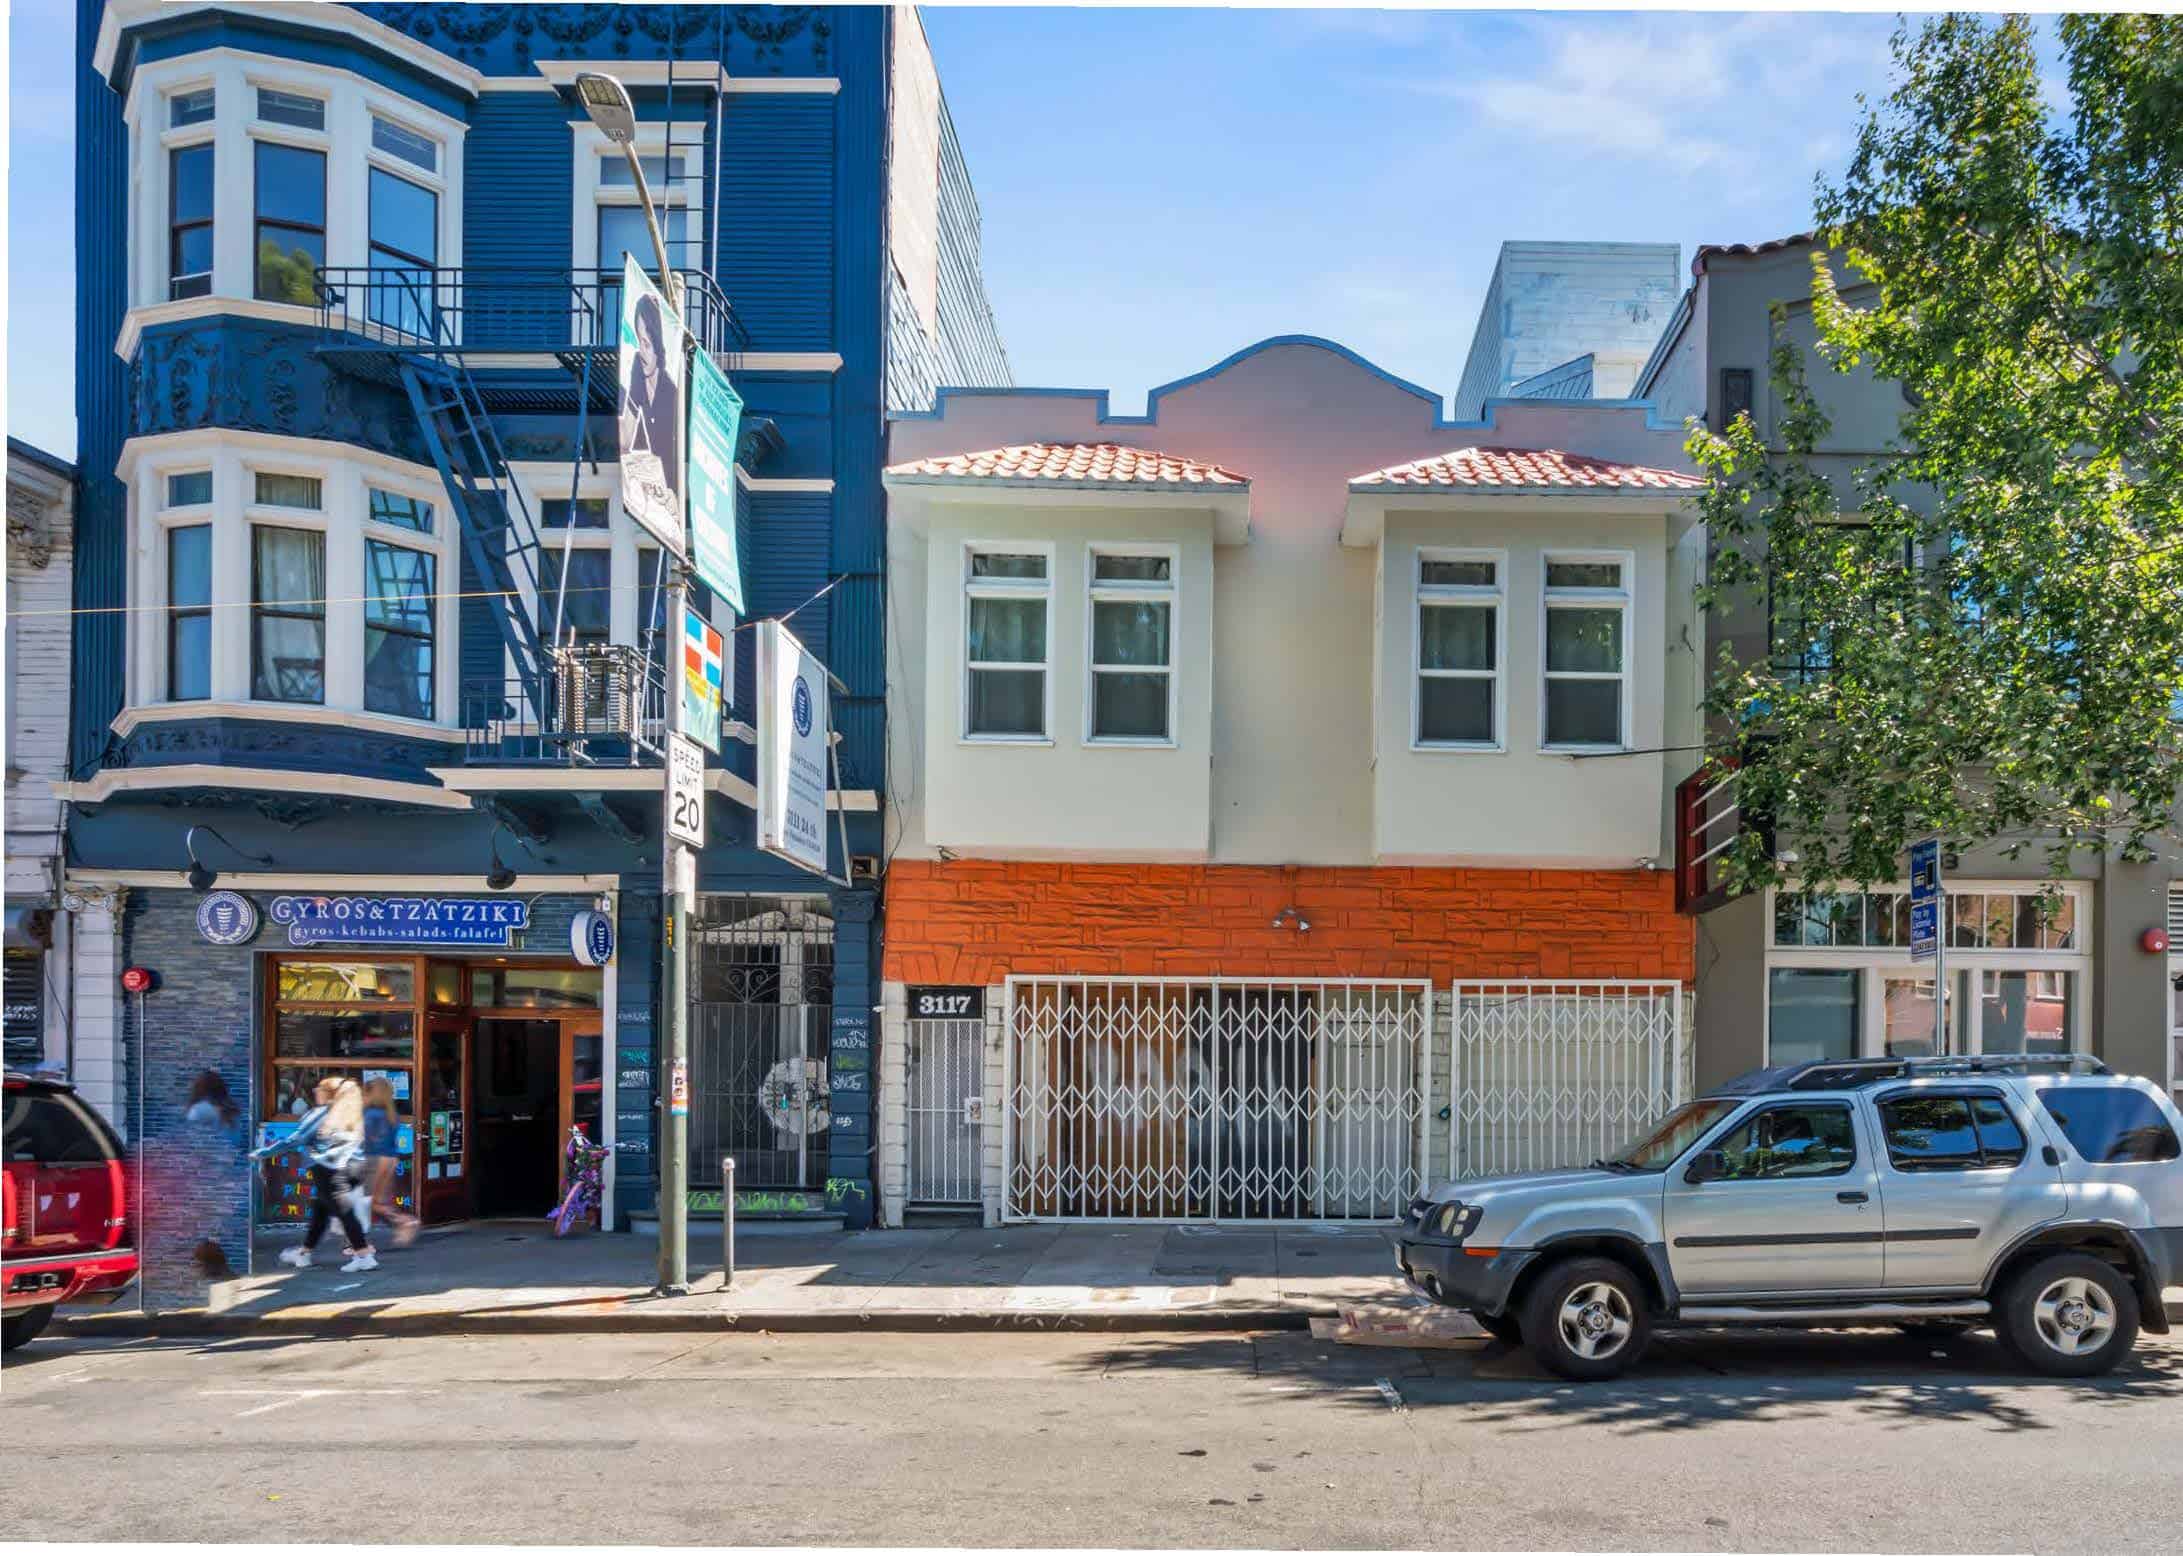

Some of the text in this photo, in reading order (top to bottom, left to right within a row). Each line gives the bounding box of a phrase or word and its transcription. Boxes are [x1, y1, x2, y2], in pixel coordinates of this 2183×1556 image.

[673, 747, 700, 774] SPEED
[676, 769, 699, 792] LIMIT
[674, 791, 699, 832] 20
[276, 902, 522, 922] GYROS&TZATZIKI
[919, 995, 972, 1014] 3117
